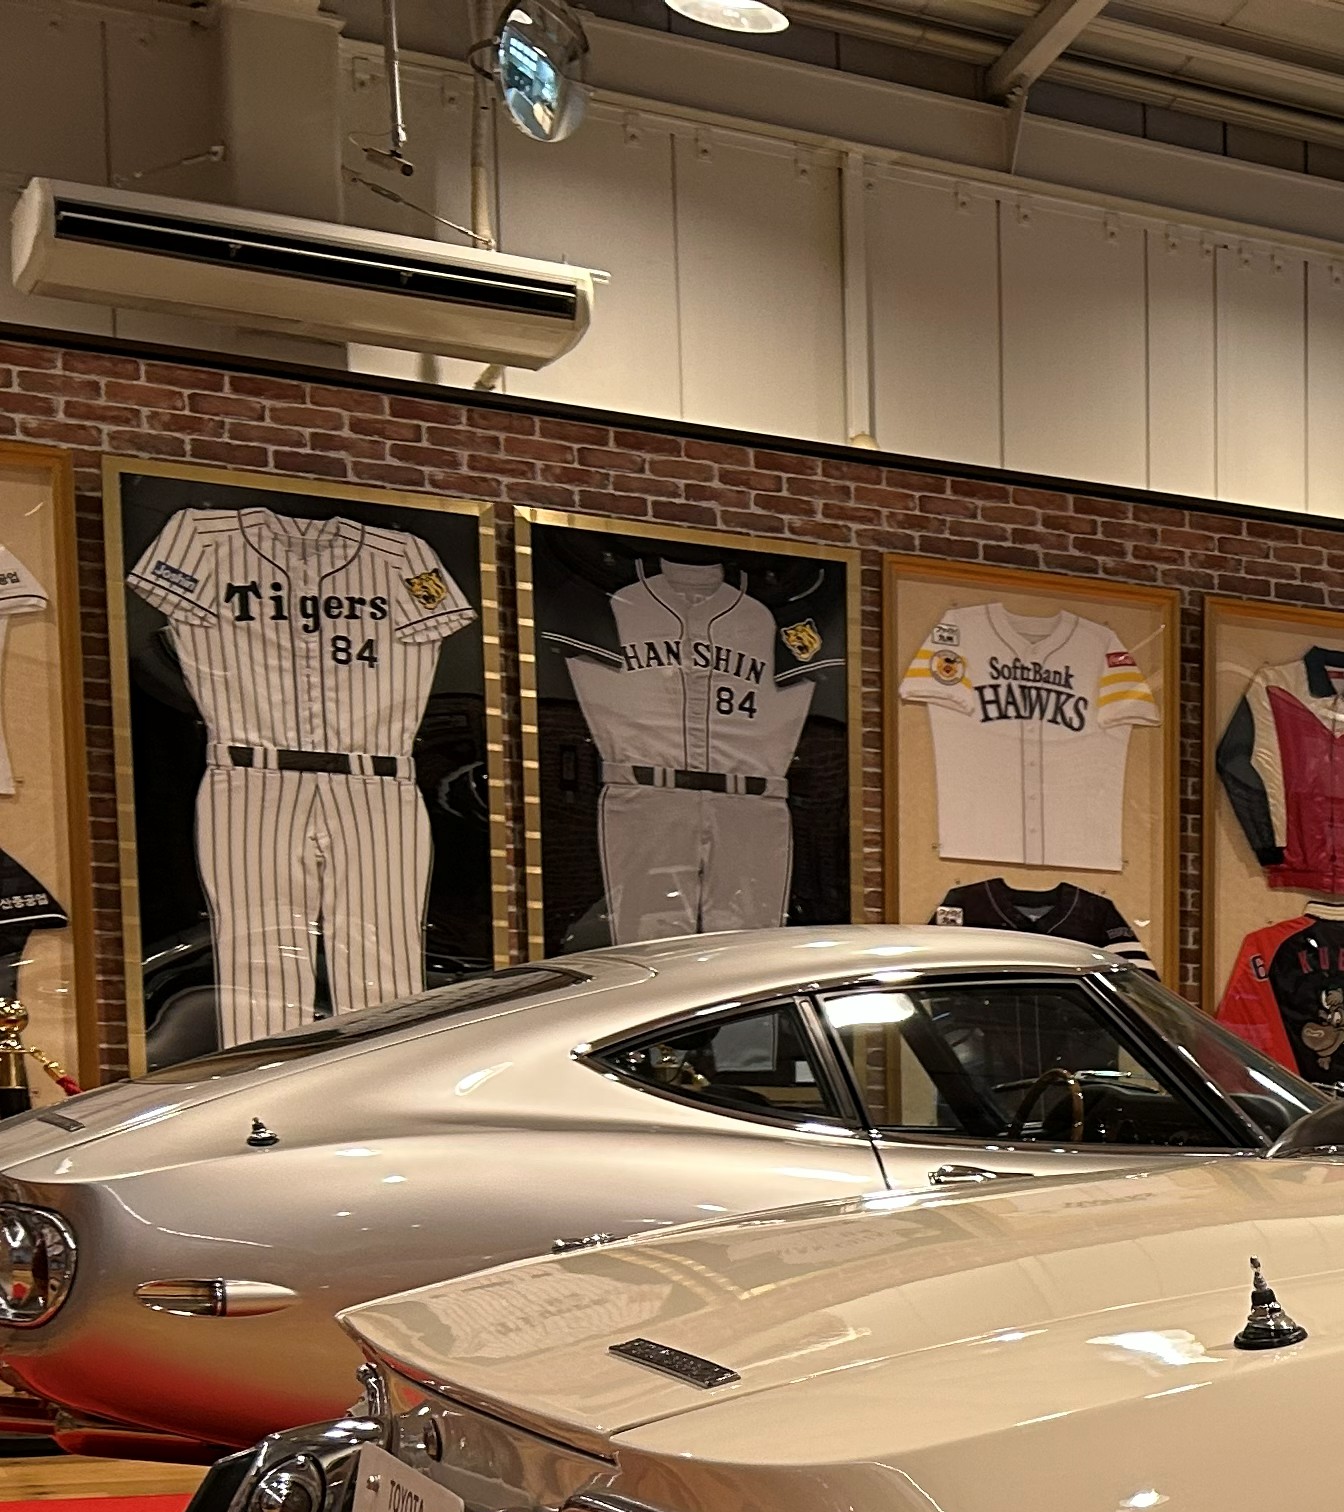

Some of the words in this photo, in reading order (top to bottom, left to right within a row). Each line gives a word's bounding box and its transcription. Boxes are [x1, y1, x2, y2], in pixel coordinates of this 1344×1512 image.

[224, 580, 388, 633] Tigers
[331, 635, 378, 668] 84
[989, 656, 1075, 690] SoftBank
[716, 686, 757, 718] 84
[974, 682, 1088, 731] HAWKS
